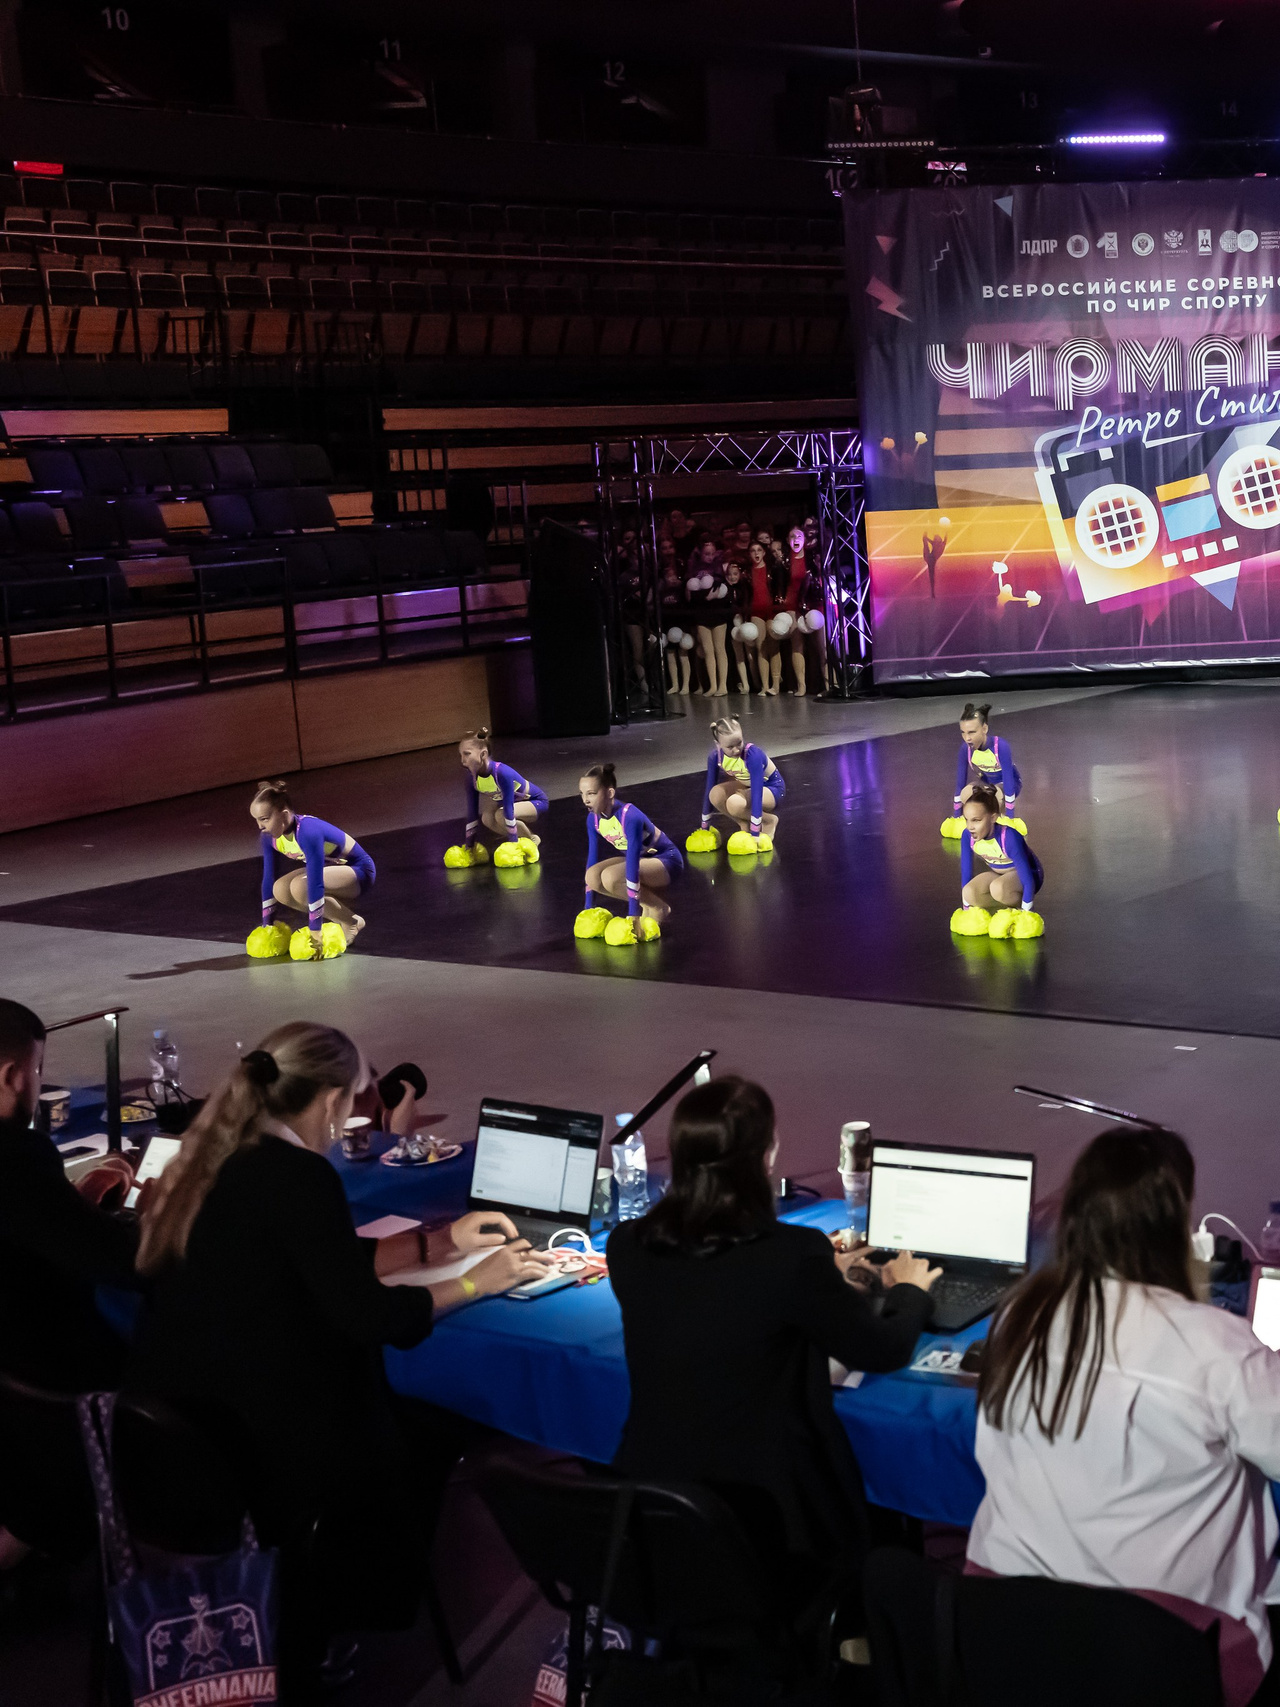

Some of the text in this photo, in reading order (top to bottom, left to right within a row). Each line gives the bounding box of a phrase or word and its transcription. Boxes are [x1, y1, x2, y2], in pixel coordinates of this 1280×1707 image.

[101, 7, 130, 32] 10
[377, 38, 401, 61] 11
[602, 61, 626, 83] 12
[1018, 91, 1040, 110] 13
[1220, 100, 1240, 118] 14
[1020, 239, 1058, 257] ЛДПР
[981, 278, 1178, 299] ВСЕРОССИЙСКИЕ
[1087, 293, 1268, 313] ПО ЧИР СПОРТУ
[1076, 405, 1183, 447] Ретро
